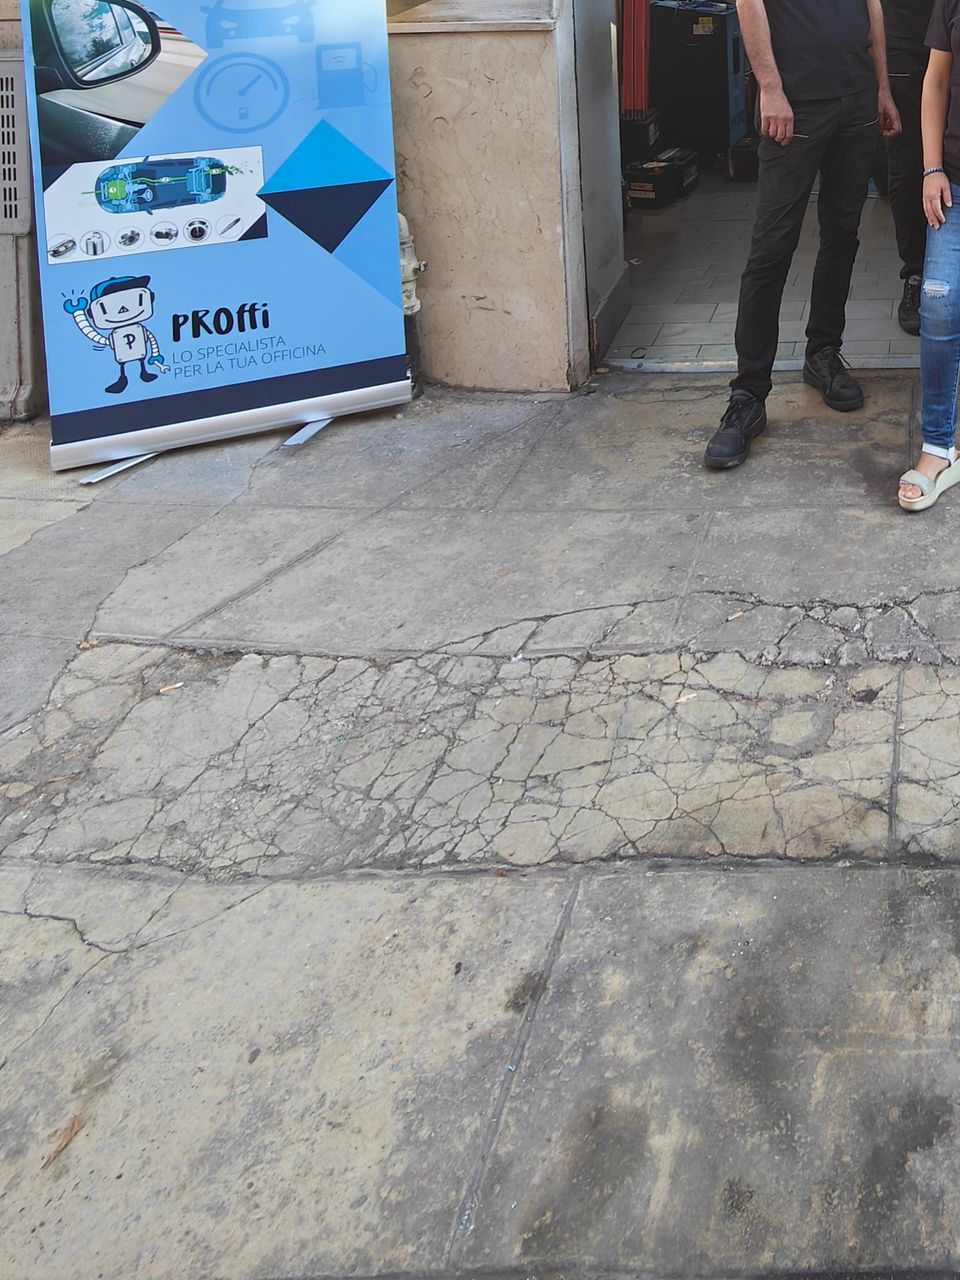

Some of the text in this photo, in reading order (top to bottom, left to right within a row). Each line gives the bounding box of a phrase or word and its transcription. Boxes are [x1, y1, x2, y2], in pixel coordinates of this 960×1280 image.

[172, 335, 287, 365] LO SPECIALISTA
[174, 343, 327, 380] PER LA TUA OFFICINA
